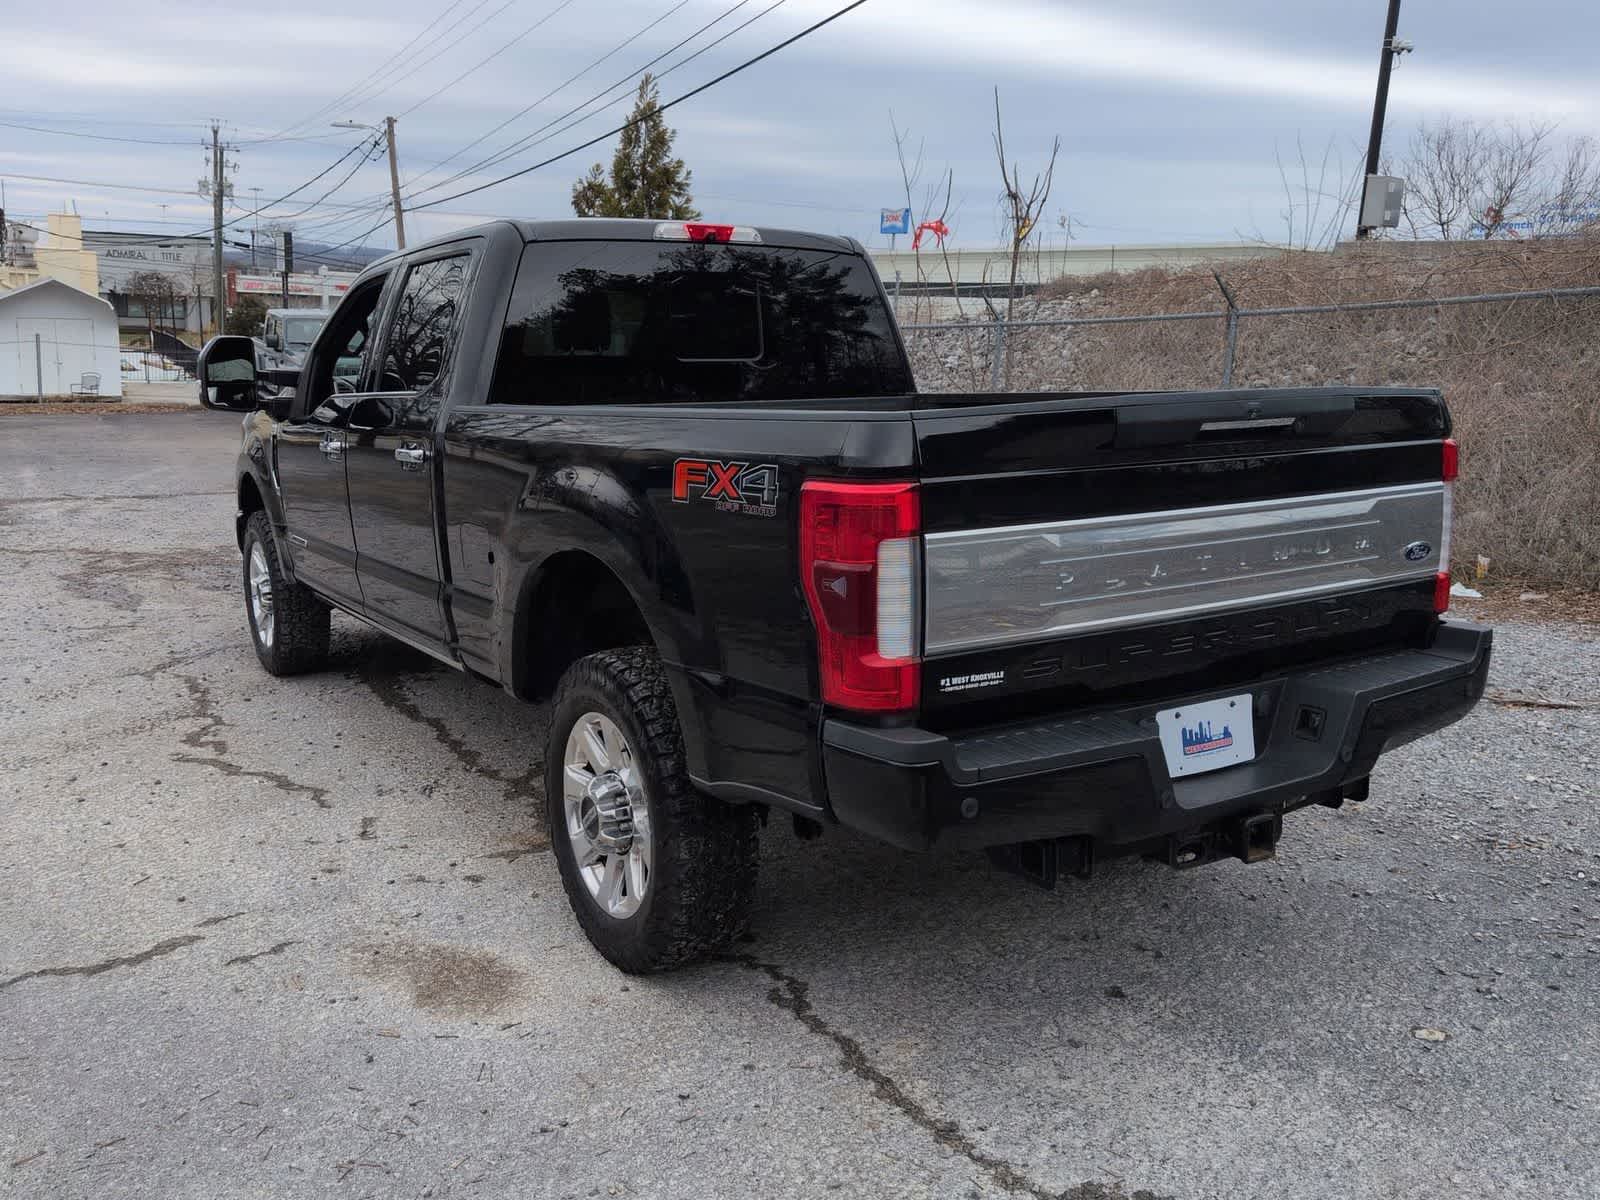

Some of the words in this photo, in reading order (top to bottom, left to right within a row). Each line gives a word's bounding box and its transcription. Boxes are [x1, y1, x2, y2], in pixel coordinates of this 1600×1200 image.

[105, 248, 147, 260] ADMIRAL
[161, 251, 183, 262] TITLE
[672, 457, 779, 507] FX4
[1022, 629, 1232, 681] SUPER
[940, 678, 951, 687] #1
[951, 676, 970, 685] WEST
[970, 671, 1004, 682] KNOXVILLE
